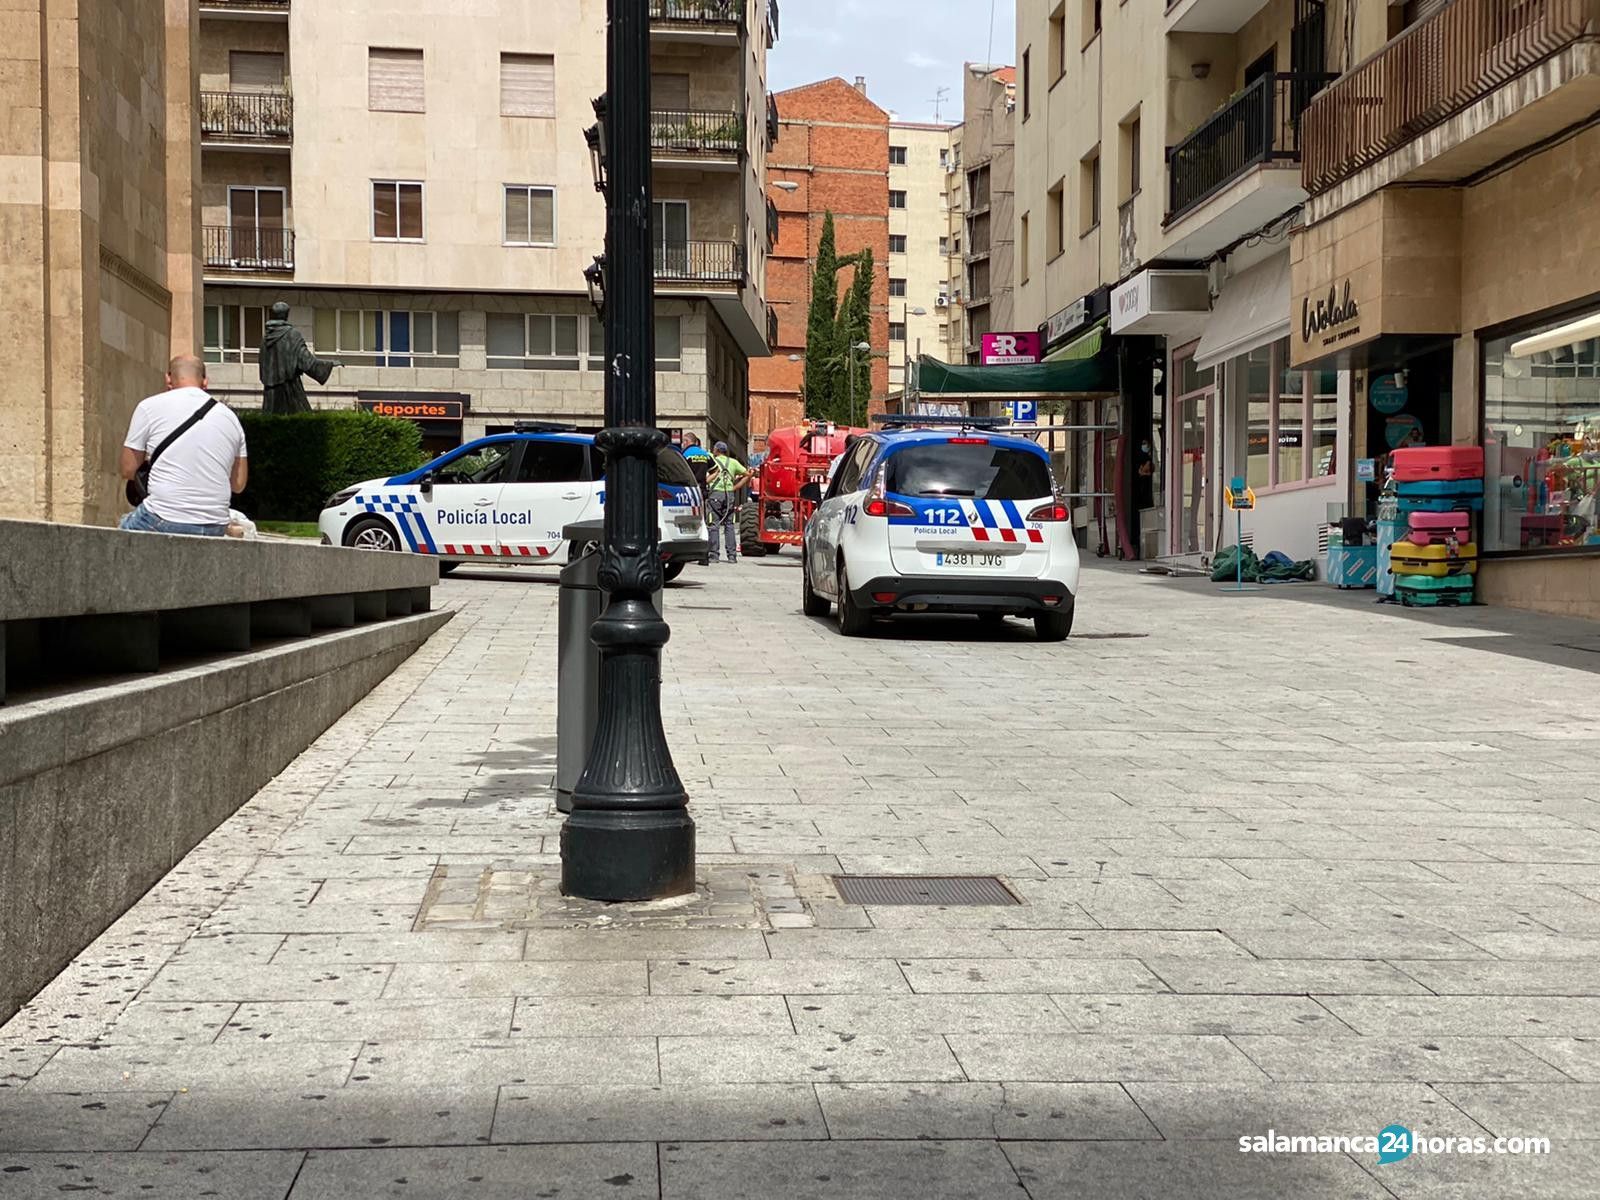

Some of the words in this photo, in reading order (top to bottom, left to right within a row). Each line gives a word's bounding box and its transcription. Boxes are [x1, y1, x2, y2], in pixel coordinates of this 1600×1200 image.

[373, 402, 446, 416] deportes
[1017, 400, 1033, 419] P
[675, 492, 690, 504] 112
[437, 509, 487, 524] Policía
[493, 509, 531, 524] Local
[844, 504, 858, 525] 112
[923, 508, 960, 524] 112
[938, 527, 957, 535] Local
[1031, 522, 1044, 530] 706
[546, 531, 561, 539] 704
[944, 554, 975, 566] 4381
[979, 554, 1002, 567] JVG
